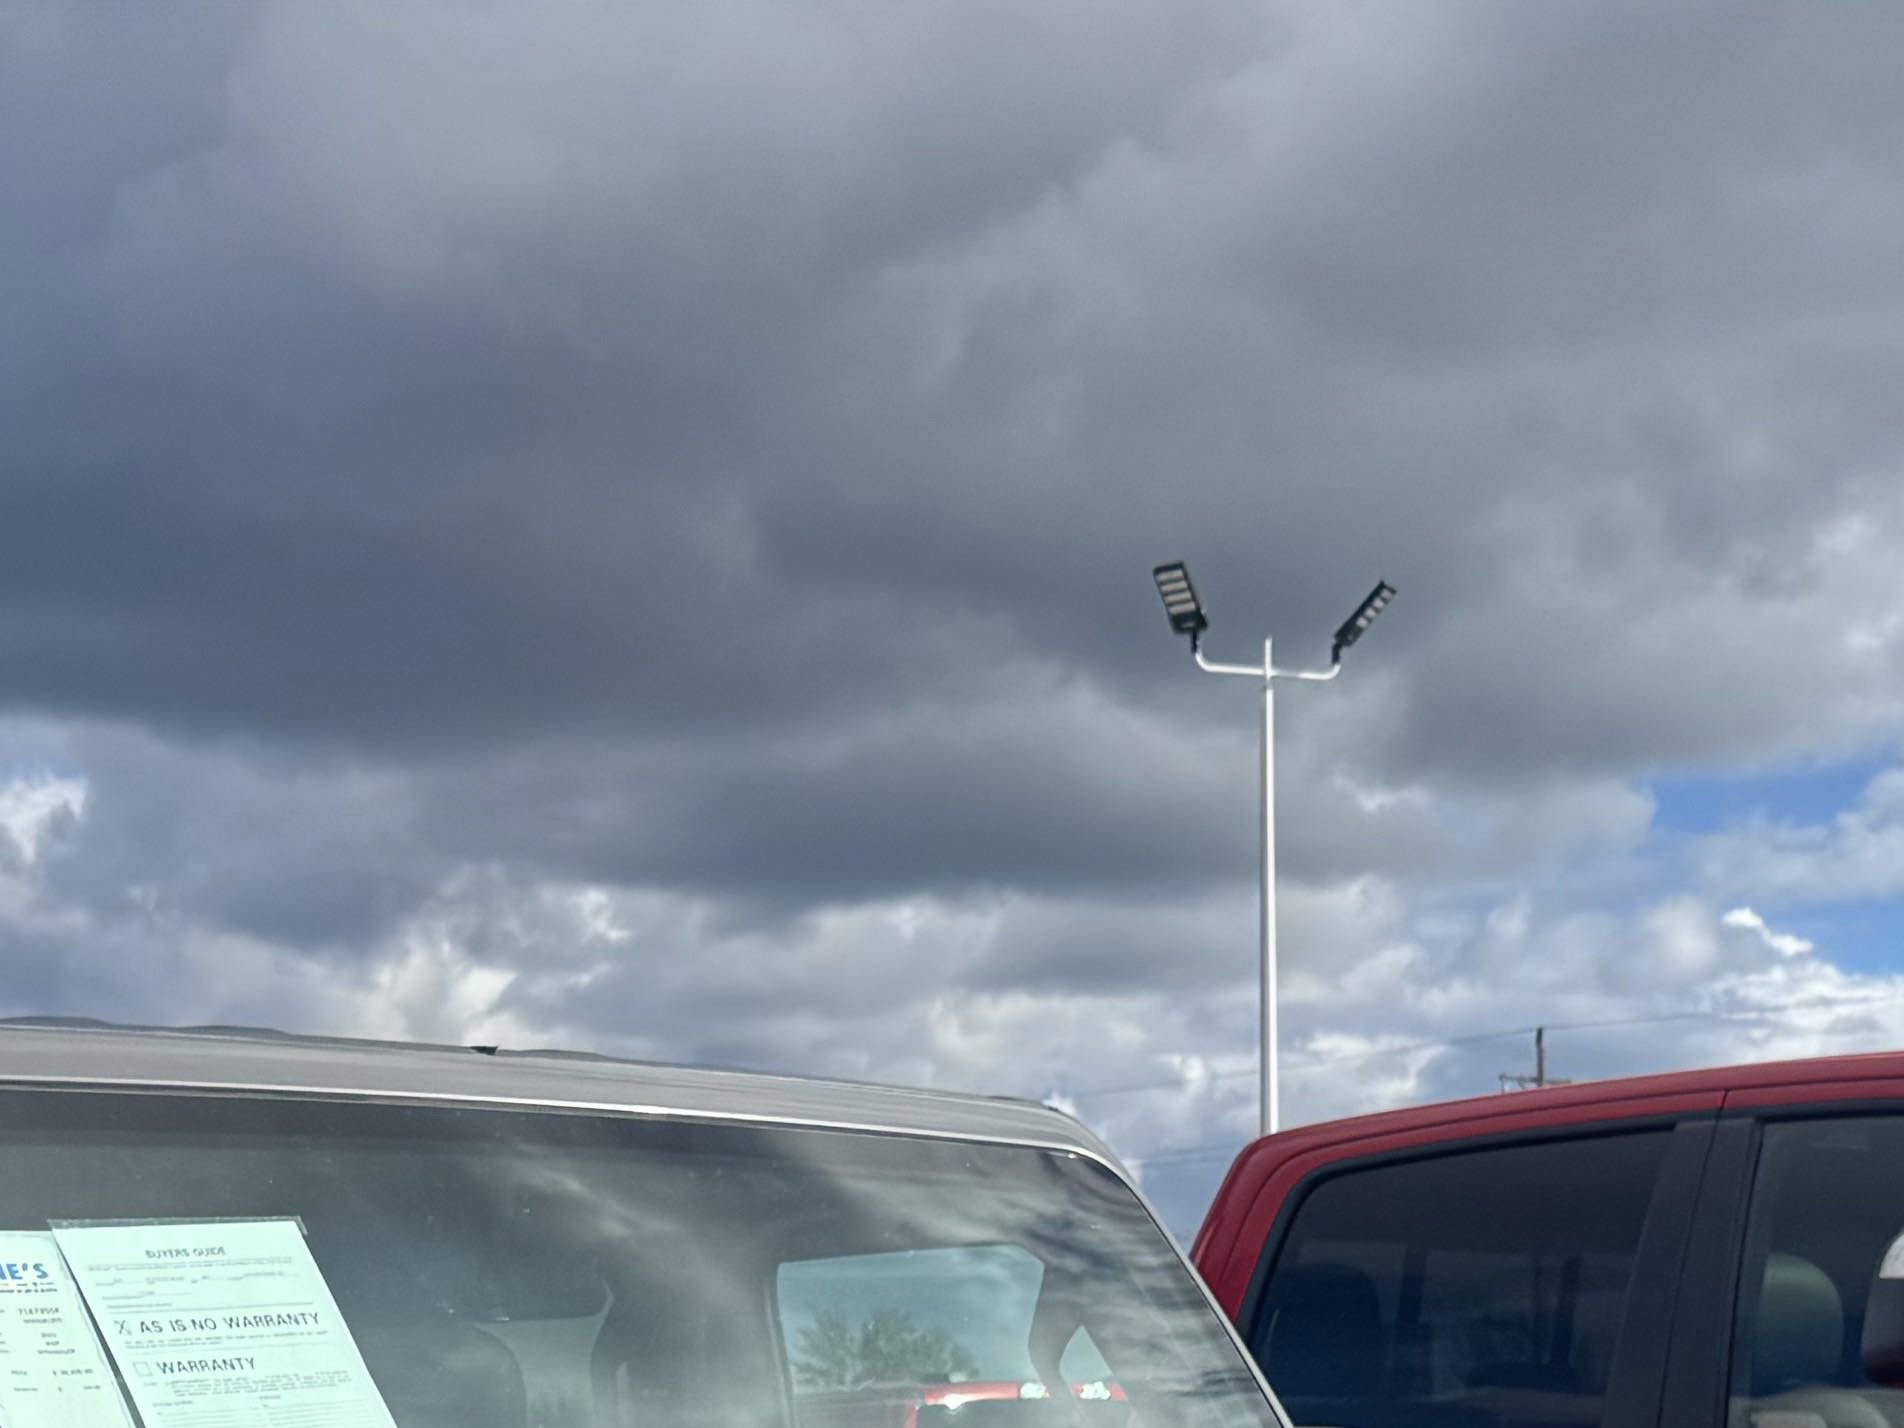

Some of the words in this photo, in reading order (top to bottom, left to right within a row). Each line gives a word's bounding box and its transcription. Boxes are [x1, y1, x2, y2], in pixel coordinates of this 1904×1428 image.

[140, 1320, 163, 1334] AS
[222, 1312, 320, 1329] WARRANTY
[156, 1357, 256, 1375] WARRANTY
